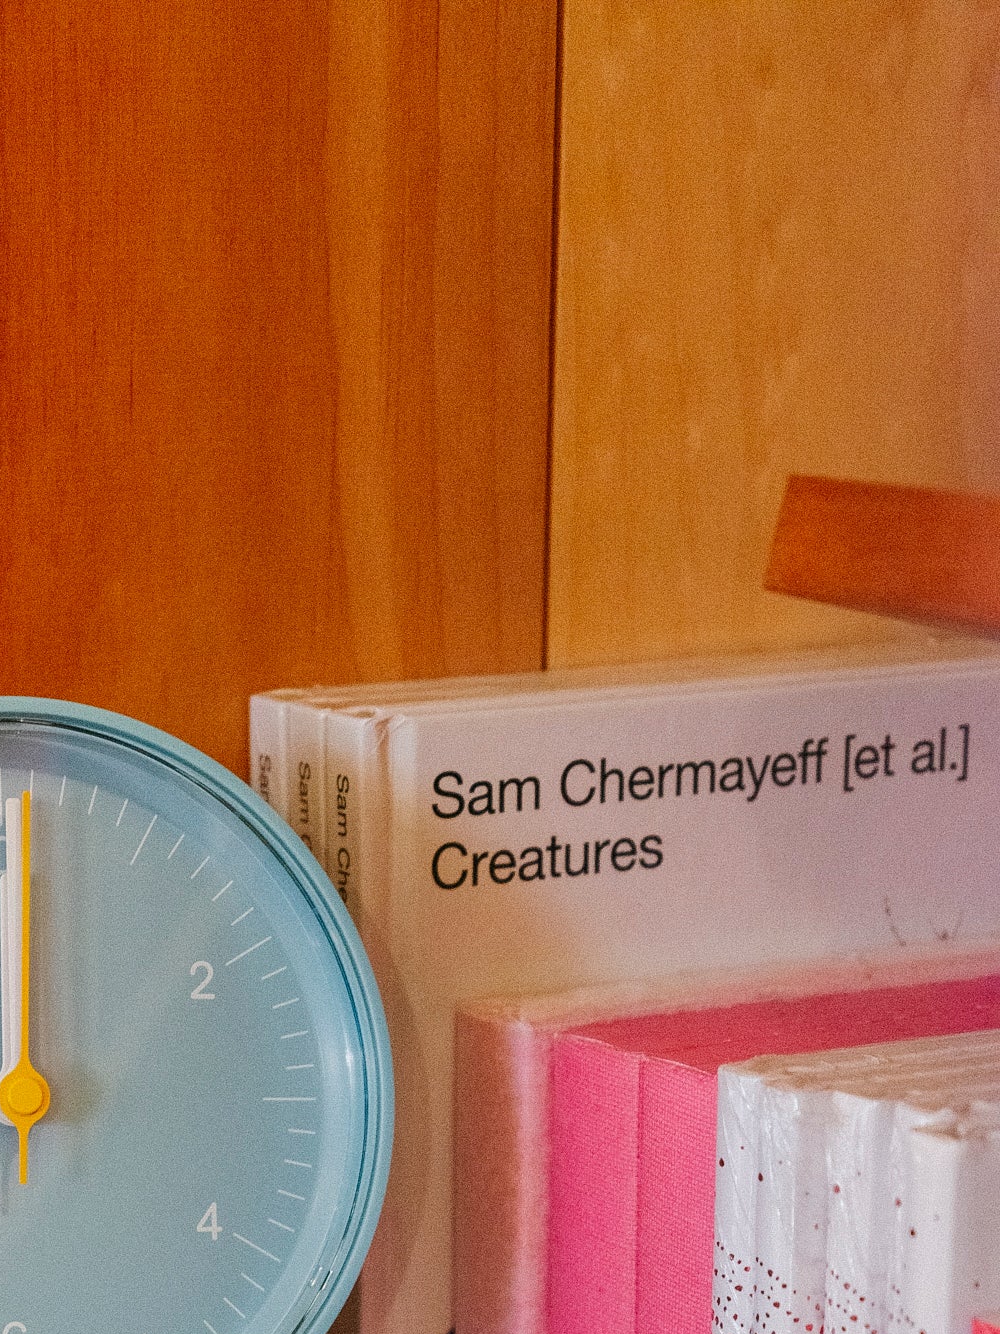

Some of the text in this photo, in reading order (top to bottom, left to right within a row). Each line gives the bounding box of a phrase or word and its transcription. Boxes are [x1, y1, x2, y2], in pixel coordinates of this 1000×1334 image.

[298, 761, 311, 824] Sam
[432, 724, 971, 820] Sam Chermayeff [et al.]
[337, 774, 350, 837] Sam
[430, 834, 664, 891] Creatures
[189, 960, 216, 1000] 2
[196, 1202, 223, 1241] 4
